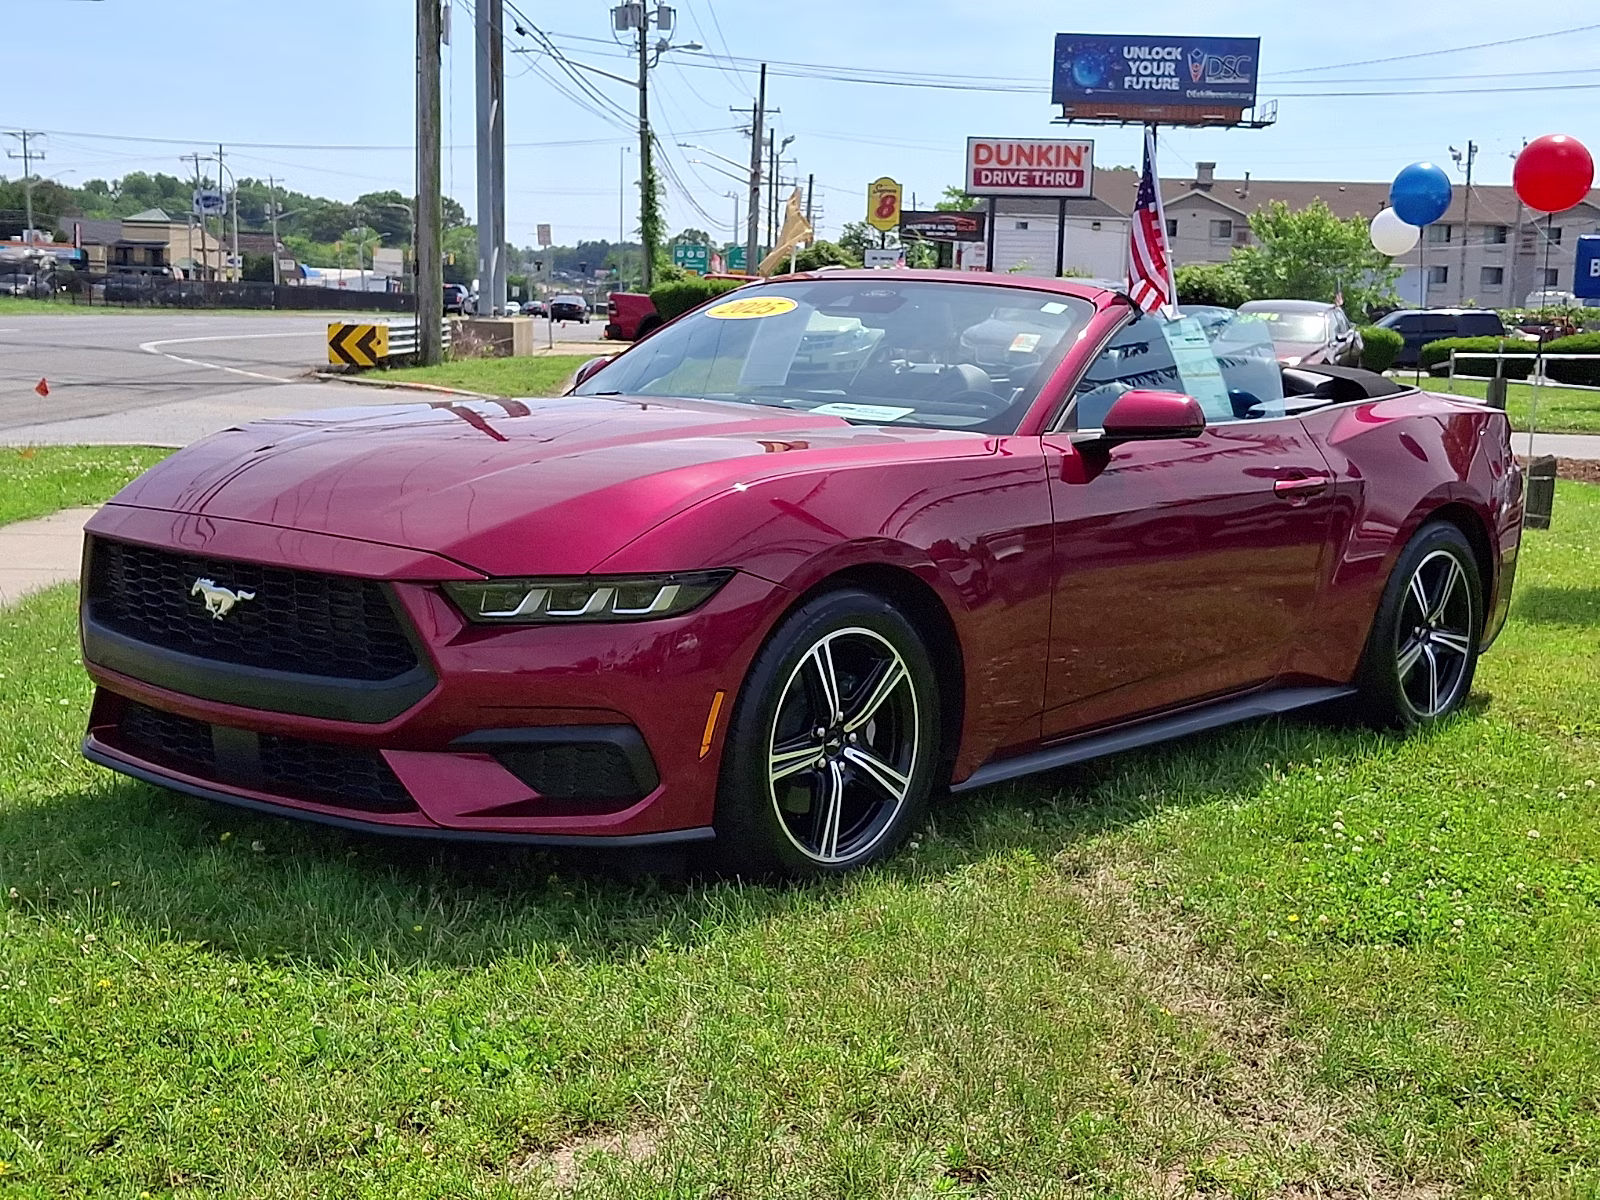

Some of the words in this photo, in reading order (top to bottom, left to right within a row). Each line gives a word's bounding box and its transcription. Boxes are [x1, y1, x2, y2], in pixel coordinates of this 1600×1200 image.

[1123, 46, 1182, 60] UNLOCK
[1128, 61, 1175, 76] YOUR
[1208, 55, 1251, 78] DSC
[1124, 77, 1180, 91] FUTURE
[974, 144, 1089, 167] DUNKIN'
[981, 171, 1028, 185] DRIVE
[1032, 172, 1077, 186] THRU
[874, 194, 896, 218] 8
[716, 302, 786, 315] 2025
